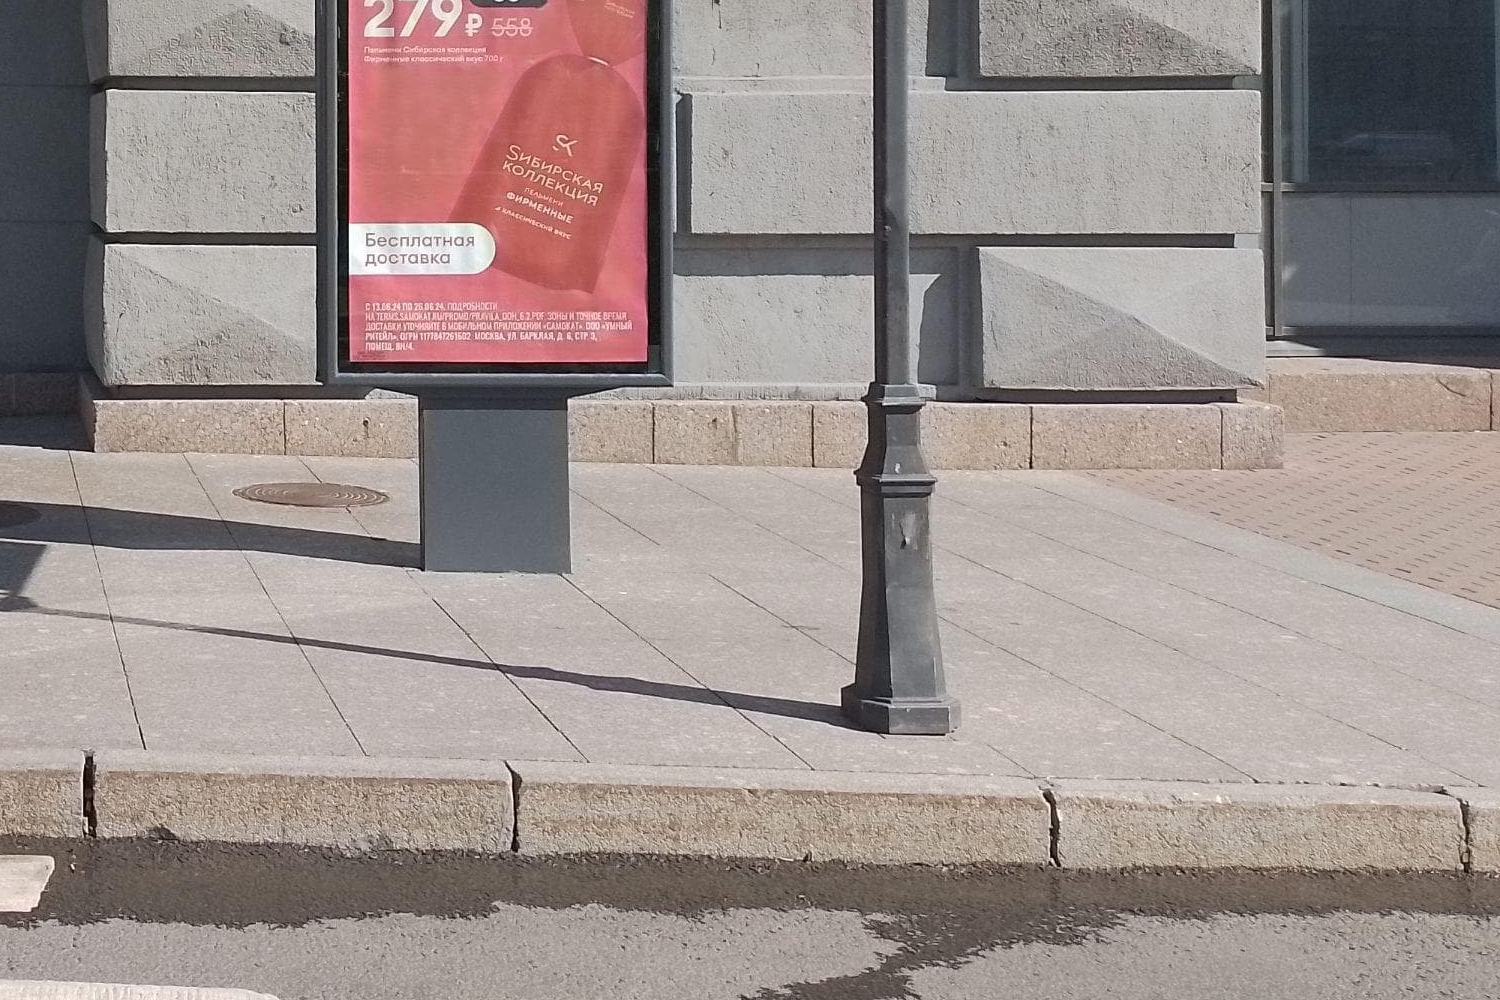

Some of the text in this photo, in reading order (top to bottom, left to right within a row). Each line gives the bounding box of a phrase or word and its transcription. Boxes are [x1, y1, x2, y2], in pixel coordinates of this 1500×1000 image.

[491, 17, 534, 38] 558
[502, 160, 599, 207] КОЛЛЕКЦИЯ
[506, 191, 574, 224] ФИРМЕННЫЕ
[501, 207, 572, 240] КЛАССИЧЕСКИЙ ВКУС
[365, 232, 475, 247] Бесплатная
[365, 253, 451, 267] доставка
[402, 302, 413, 311] ПО
